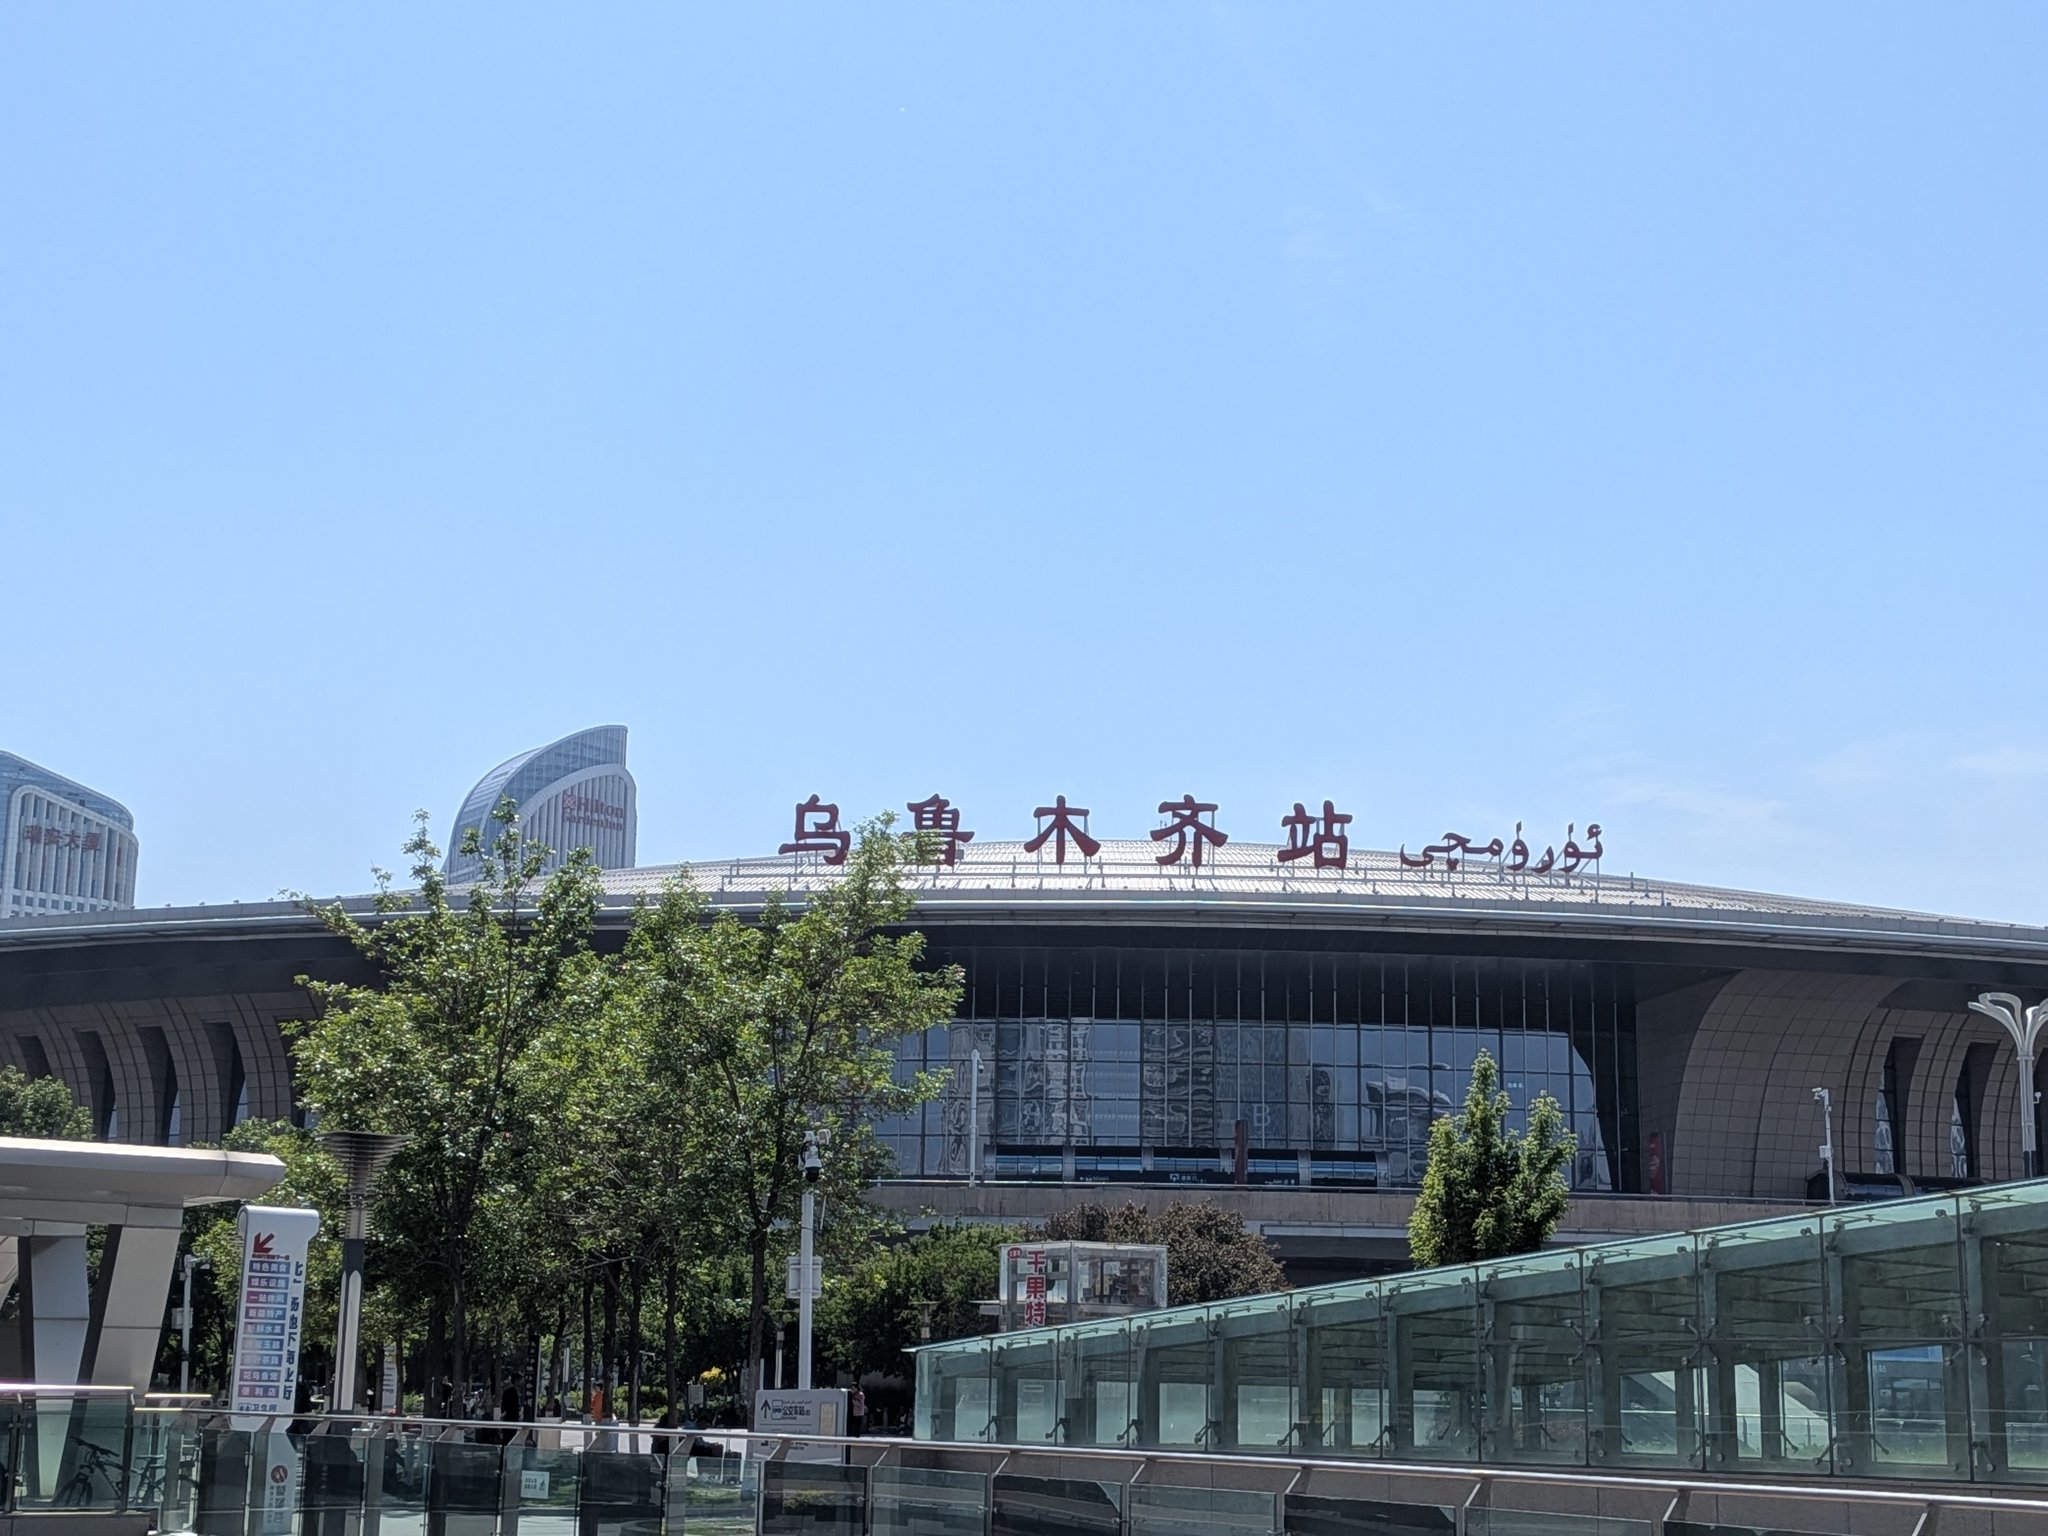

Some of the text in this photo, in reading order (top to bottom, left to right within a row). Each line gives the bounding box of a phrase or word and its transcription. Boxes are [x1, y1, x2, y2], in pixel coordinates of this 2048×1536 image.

[577, 796, 623, 818] Hilton
[778, 793, 1353, 870] 乌鲁木齐站
